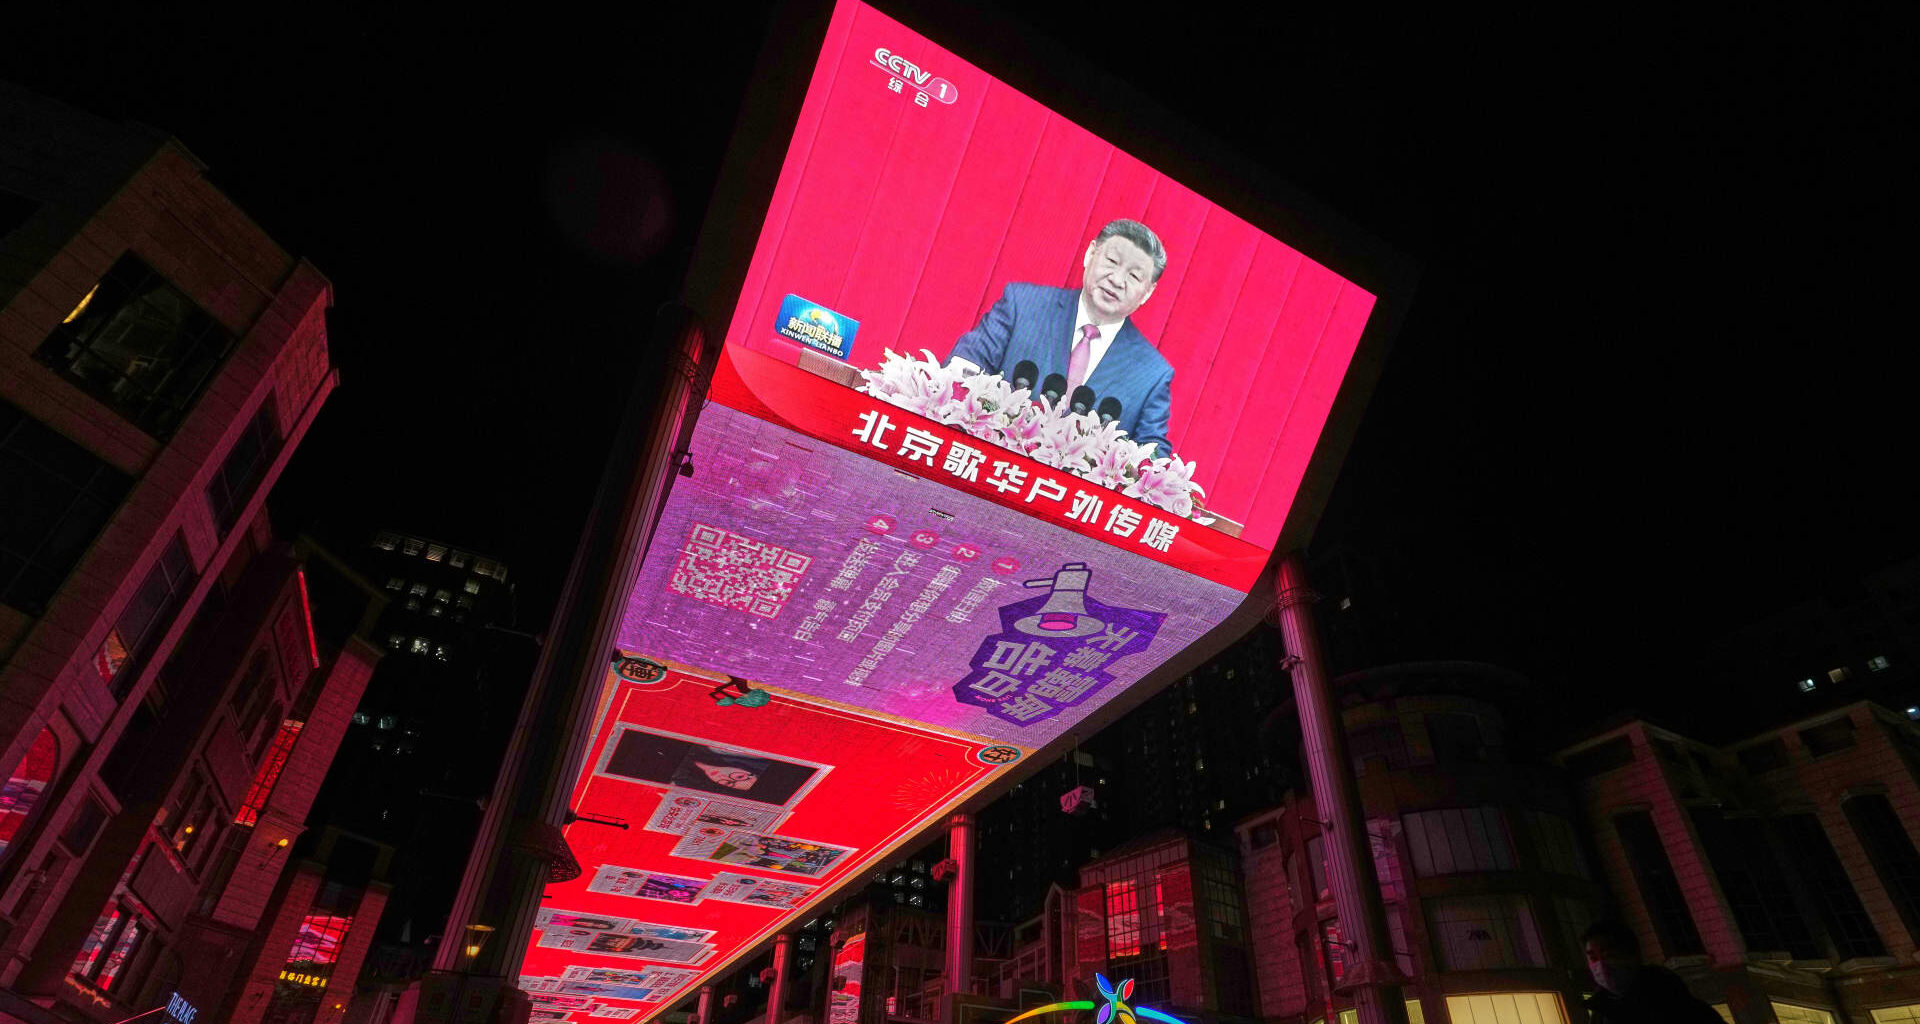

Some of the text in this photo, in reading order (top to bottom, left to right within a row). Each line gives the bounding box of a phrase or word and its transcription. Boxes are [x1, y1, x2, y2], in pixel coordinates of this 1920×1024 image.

[874, 48, 948, 99] CCTV 1
[887, 76, 930, 108] 综合
[781, 327, 812, 345] XINWEN
[788, 317, 843, 348] 新闻联播
[851, 410, 1180, 553] 北京歌华户外传媒
[872, 518, 889, 531] 4
[956, 547, 976, 558] 2
[836, 533, 934, 644] 3 进入会员支付页面
[945, 577, 1003, 624] 微信扫码
[968, 640, 1057, 698] 告白
[1001, 622, 1139, 722] 天幕霸屏
